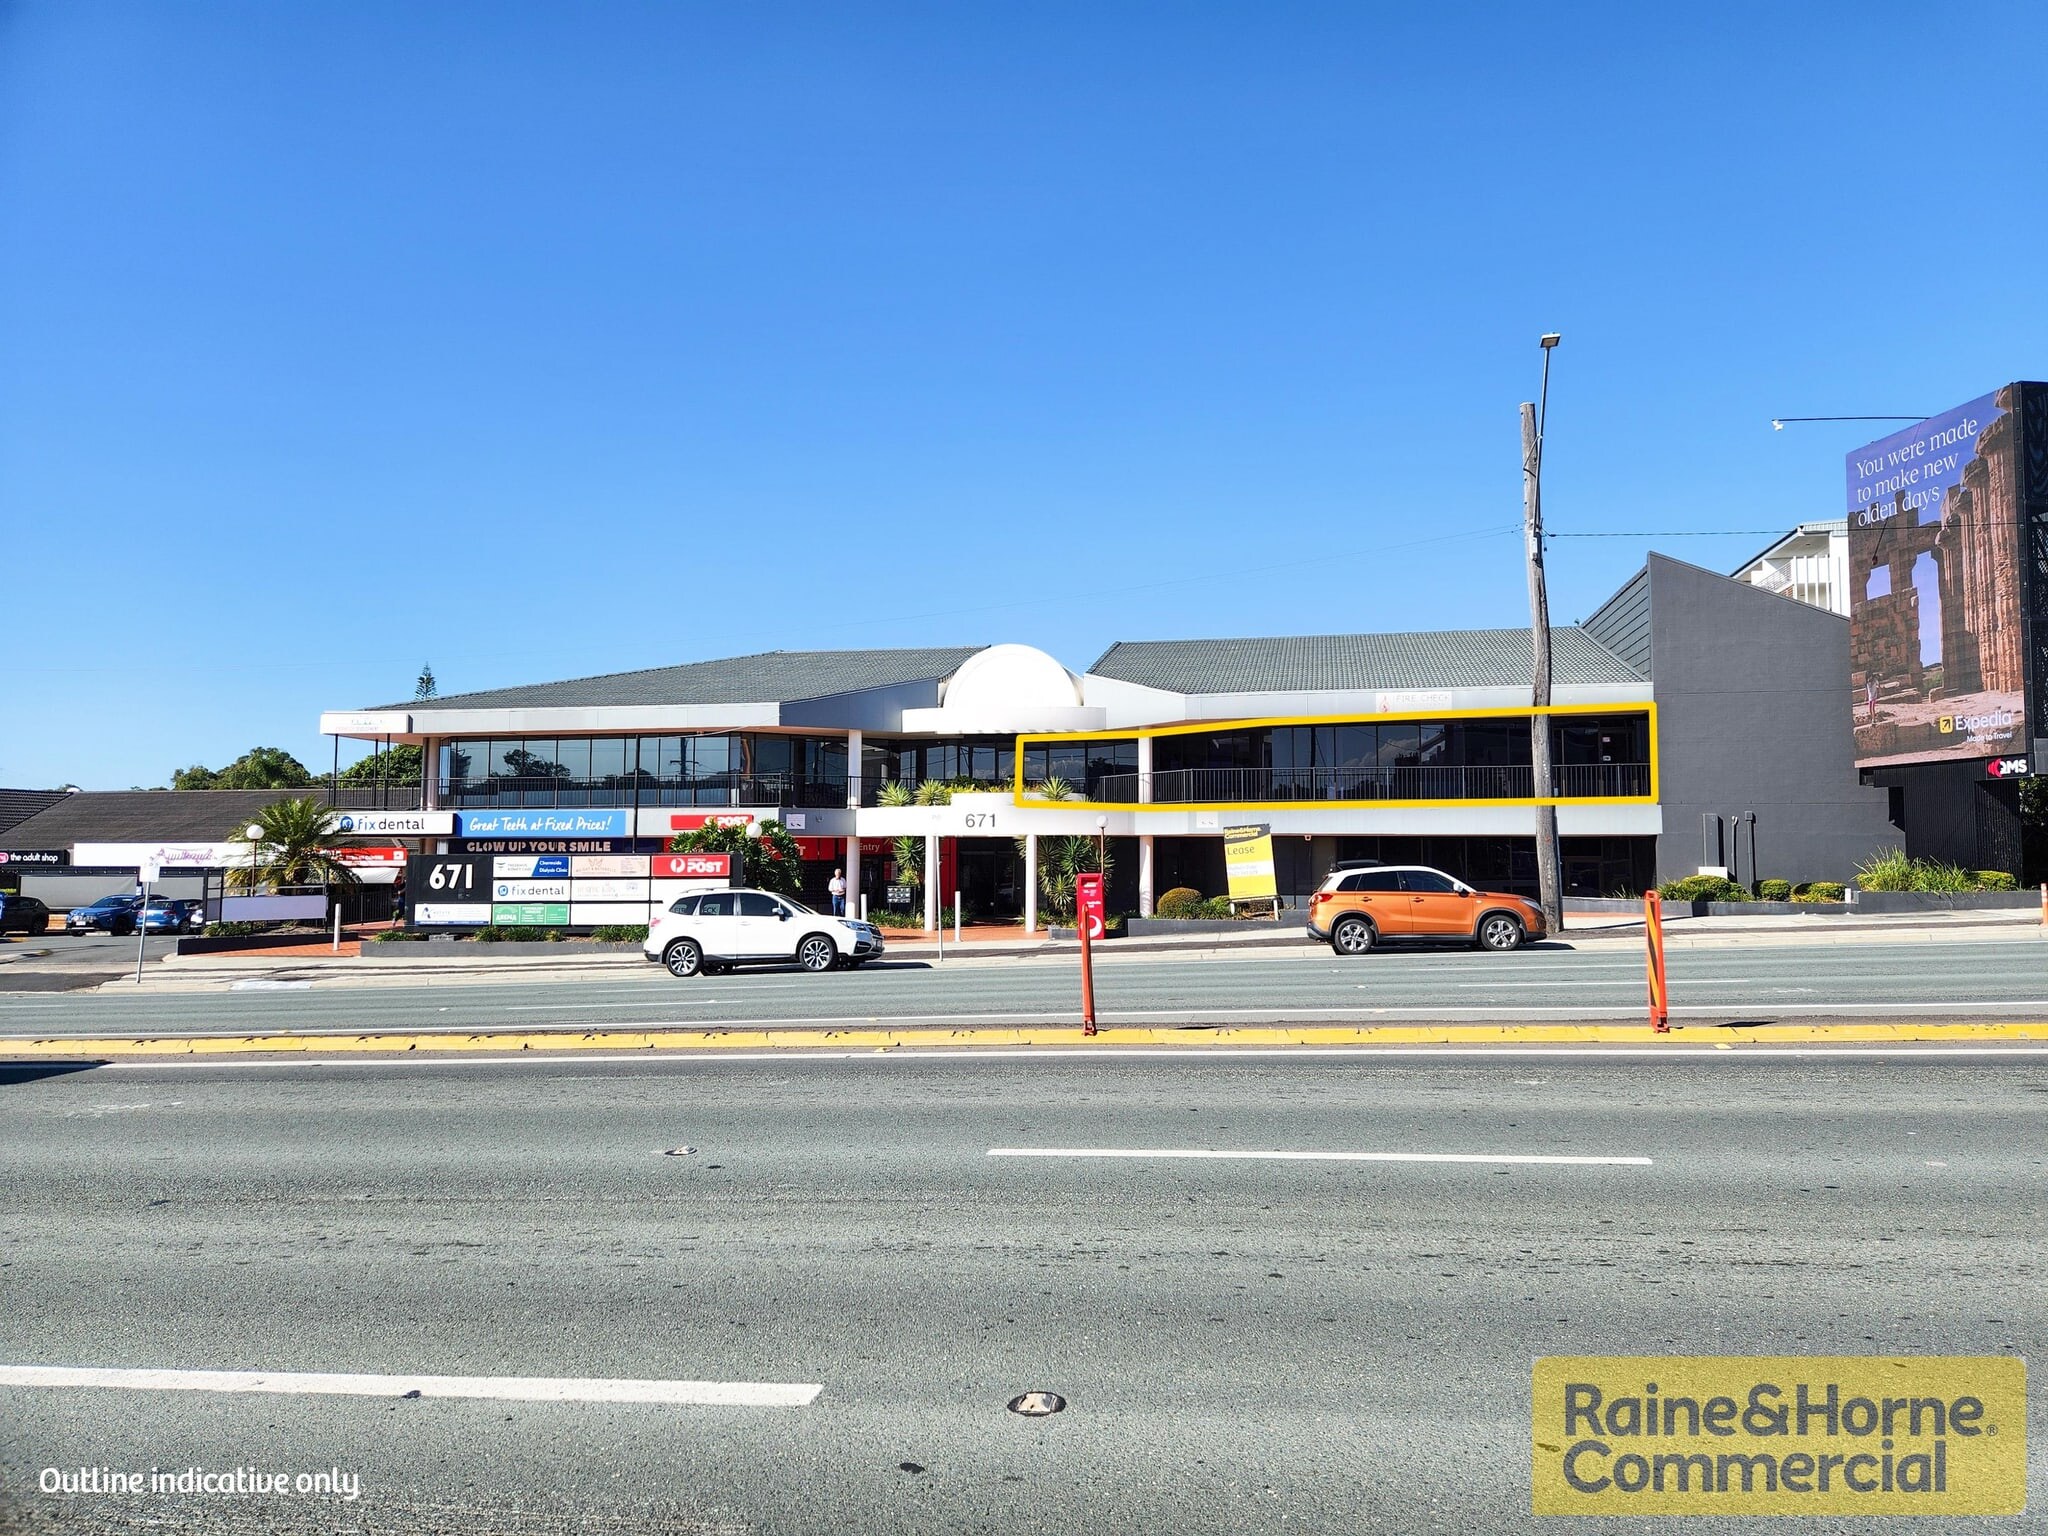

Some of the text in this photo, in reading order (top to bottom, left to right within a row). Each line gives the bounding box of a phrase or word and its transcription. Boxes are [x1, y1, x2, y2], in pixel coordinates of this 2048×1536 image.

[1856, 418, 1978, 479] You were made
[1857, 453, 1959, 504] to make new
[1858, 486, 1940, 528] olden days
[1396, 694, 1417, 702] FIRE
[1955, 710, 2012, 733] Expedia
[1993, 731, 2012, 740] Travel
[469, 815, 612, 832] Great Teeth at Fixed Prices!
[965, 813, 996, 828] 671
[466, 841, 611, 852] GLOW UP YOUR SMILE
[1227, 846, 1255, 856] Lease
[10, 852, 21, 861] the
[22, 852, 40, 861] adult
[41, 852, 58, 864] shop
[687, 861, 723, 873] POST
[429, 864, 473, 890] 671
